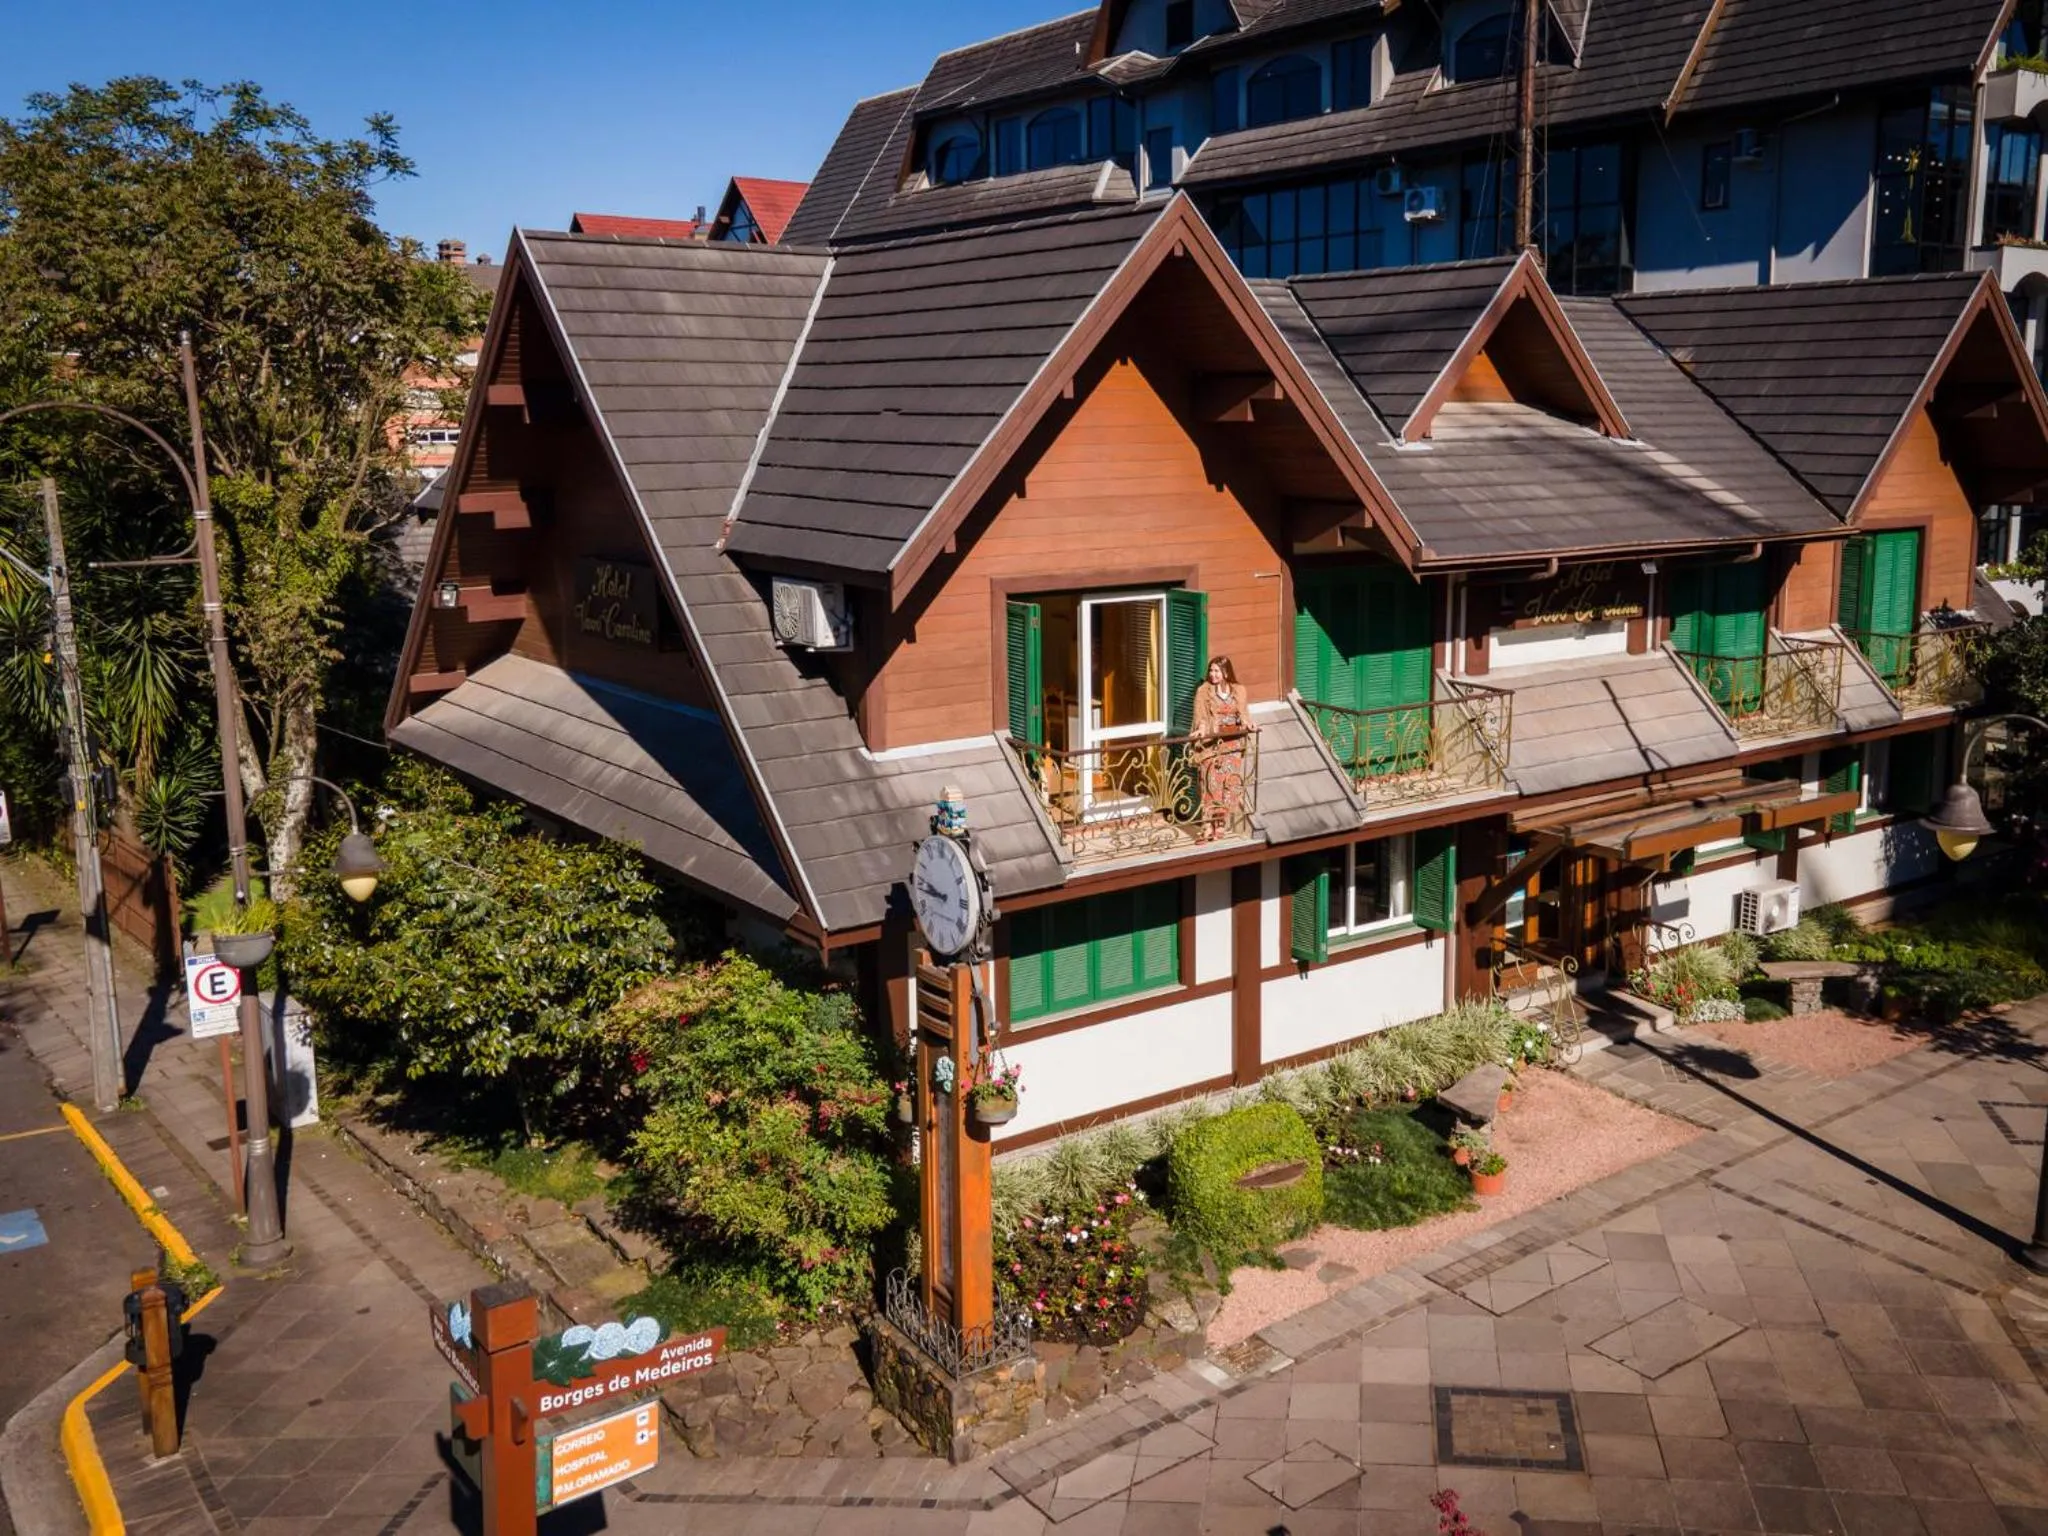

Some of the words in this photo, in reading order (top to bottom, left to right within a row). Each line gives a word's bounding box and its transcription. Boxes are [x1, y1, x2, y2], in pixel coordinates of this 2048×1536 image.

[592, 564, 630, 598] Hotel
[209, 971, 227, 996] E
[660, 1337, 713, 1361] Avenida
[539, 1383, 604, 1413] Borges
[608, 1375, 630, 1392] de
[635, 1352, 713, 1384] Medeiros
[554, 1429, 606, 1455] CORREIO
[554, 1451, 608, 1476] HOSPITAL
